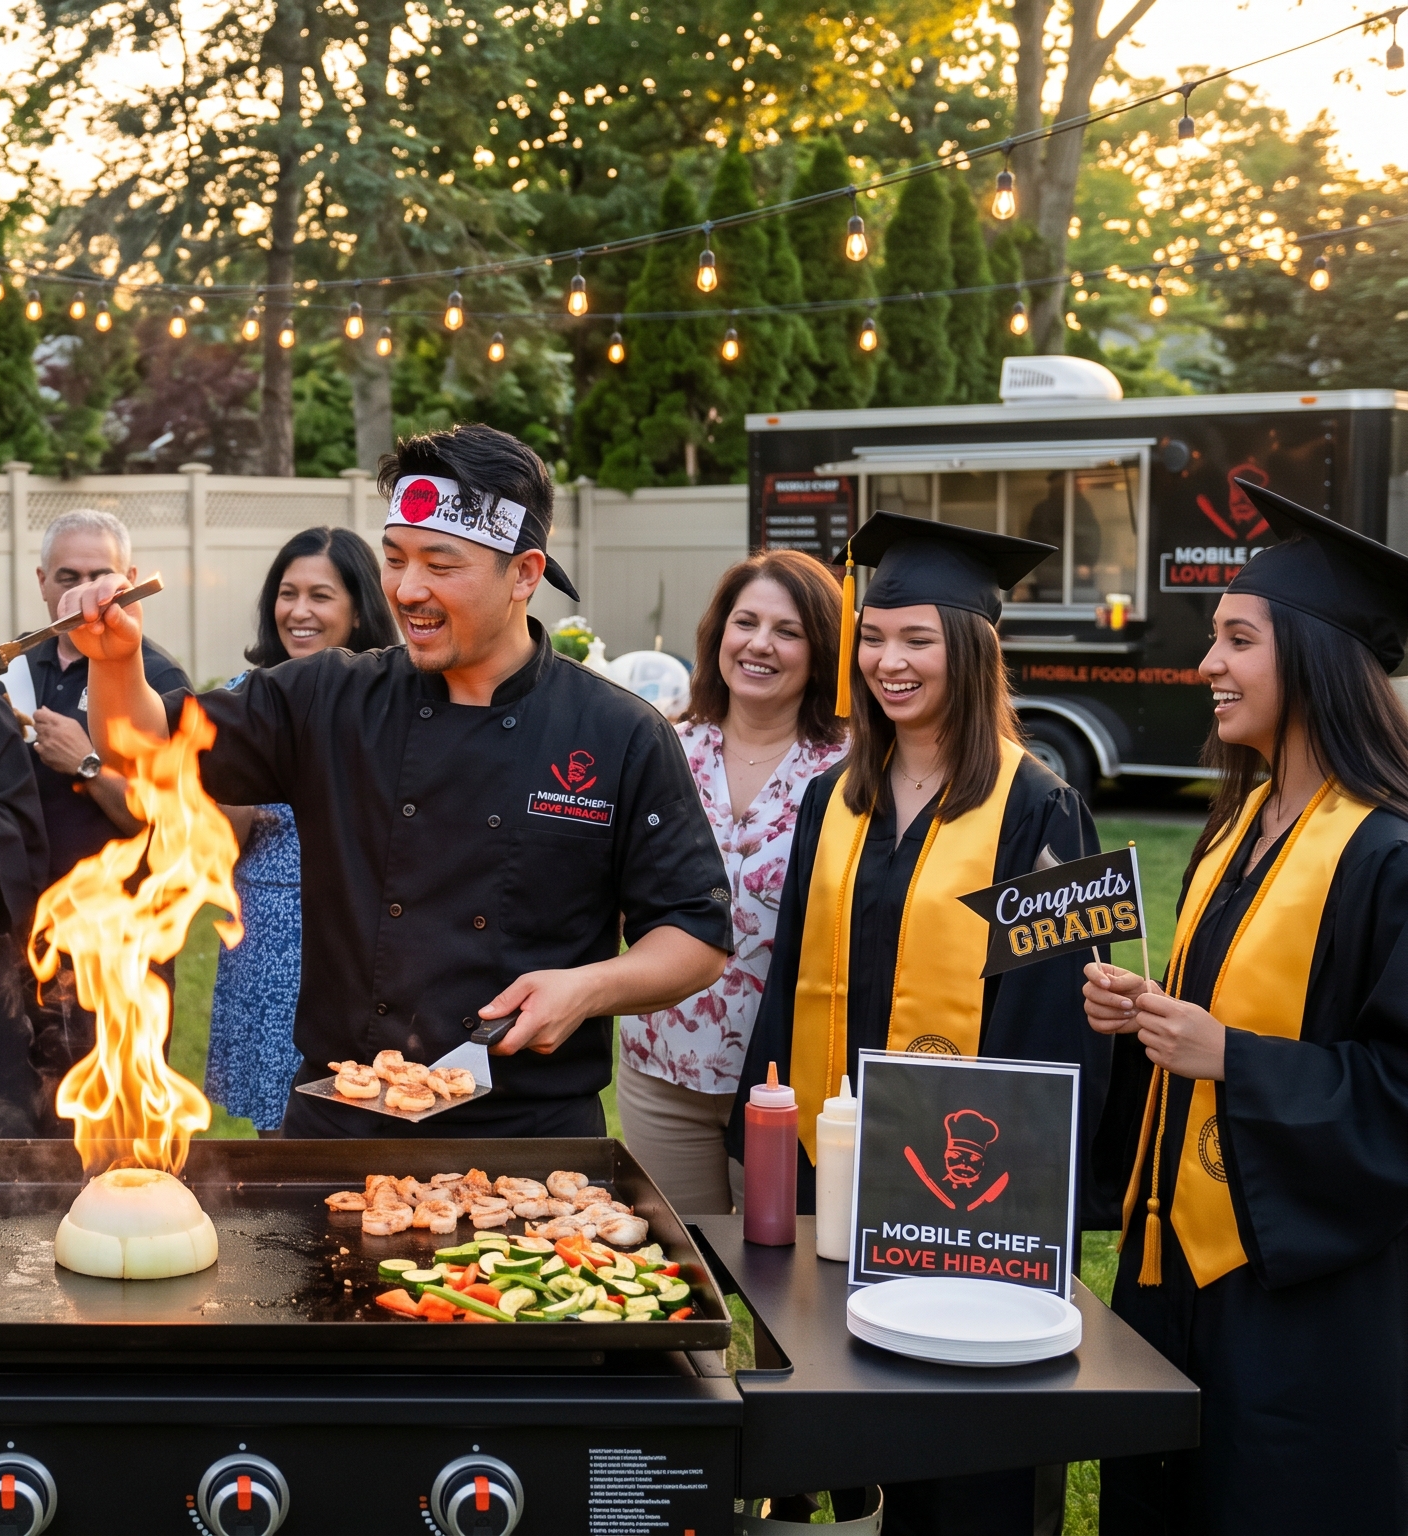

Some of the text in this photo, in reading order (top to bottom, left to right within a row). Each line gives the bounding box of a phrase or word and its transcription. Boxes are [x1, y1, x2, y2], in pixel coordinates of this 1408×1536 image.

[1174, 546, 1248, 565] MOBILE
[1170, 565, 1221, 583] LOVE
[1029, 664, 1089, 683] MOBILE
[1091, 666, 1137, 684] FOOD
[995, 867, 1131, 925] Congrats
[1008, 900, 1139, 957] GRADS
[882, 1221, 1041, 1253] MOBILE CHEF
[872, 1245, 1049, 1281] LOVE HIBACHI
